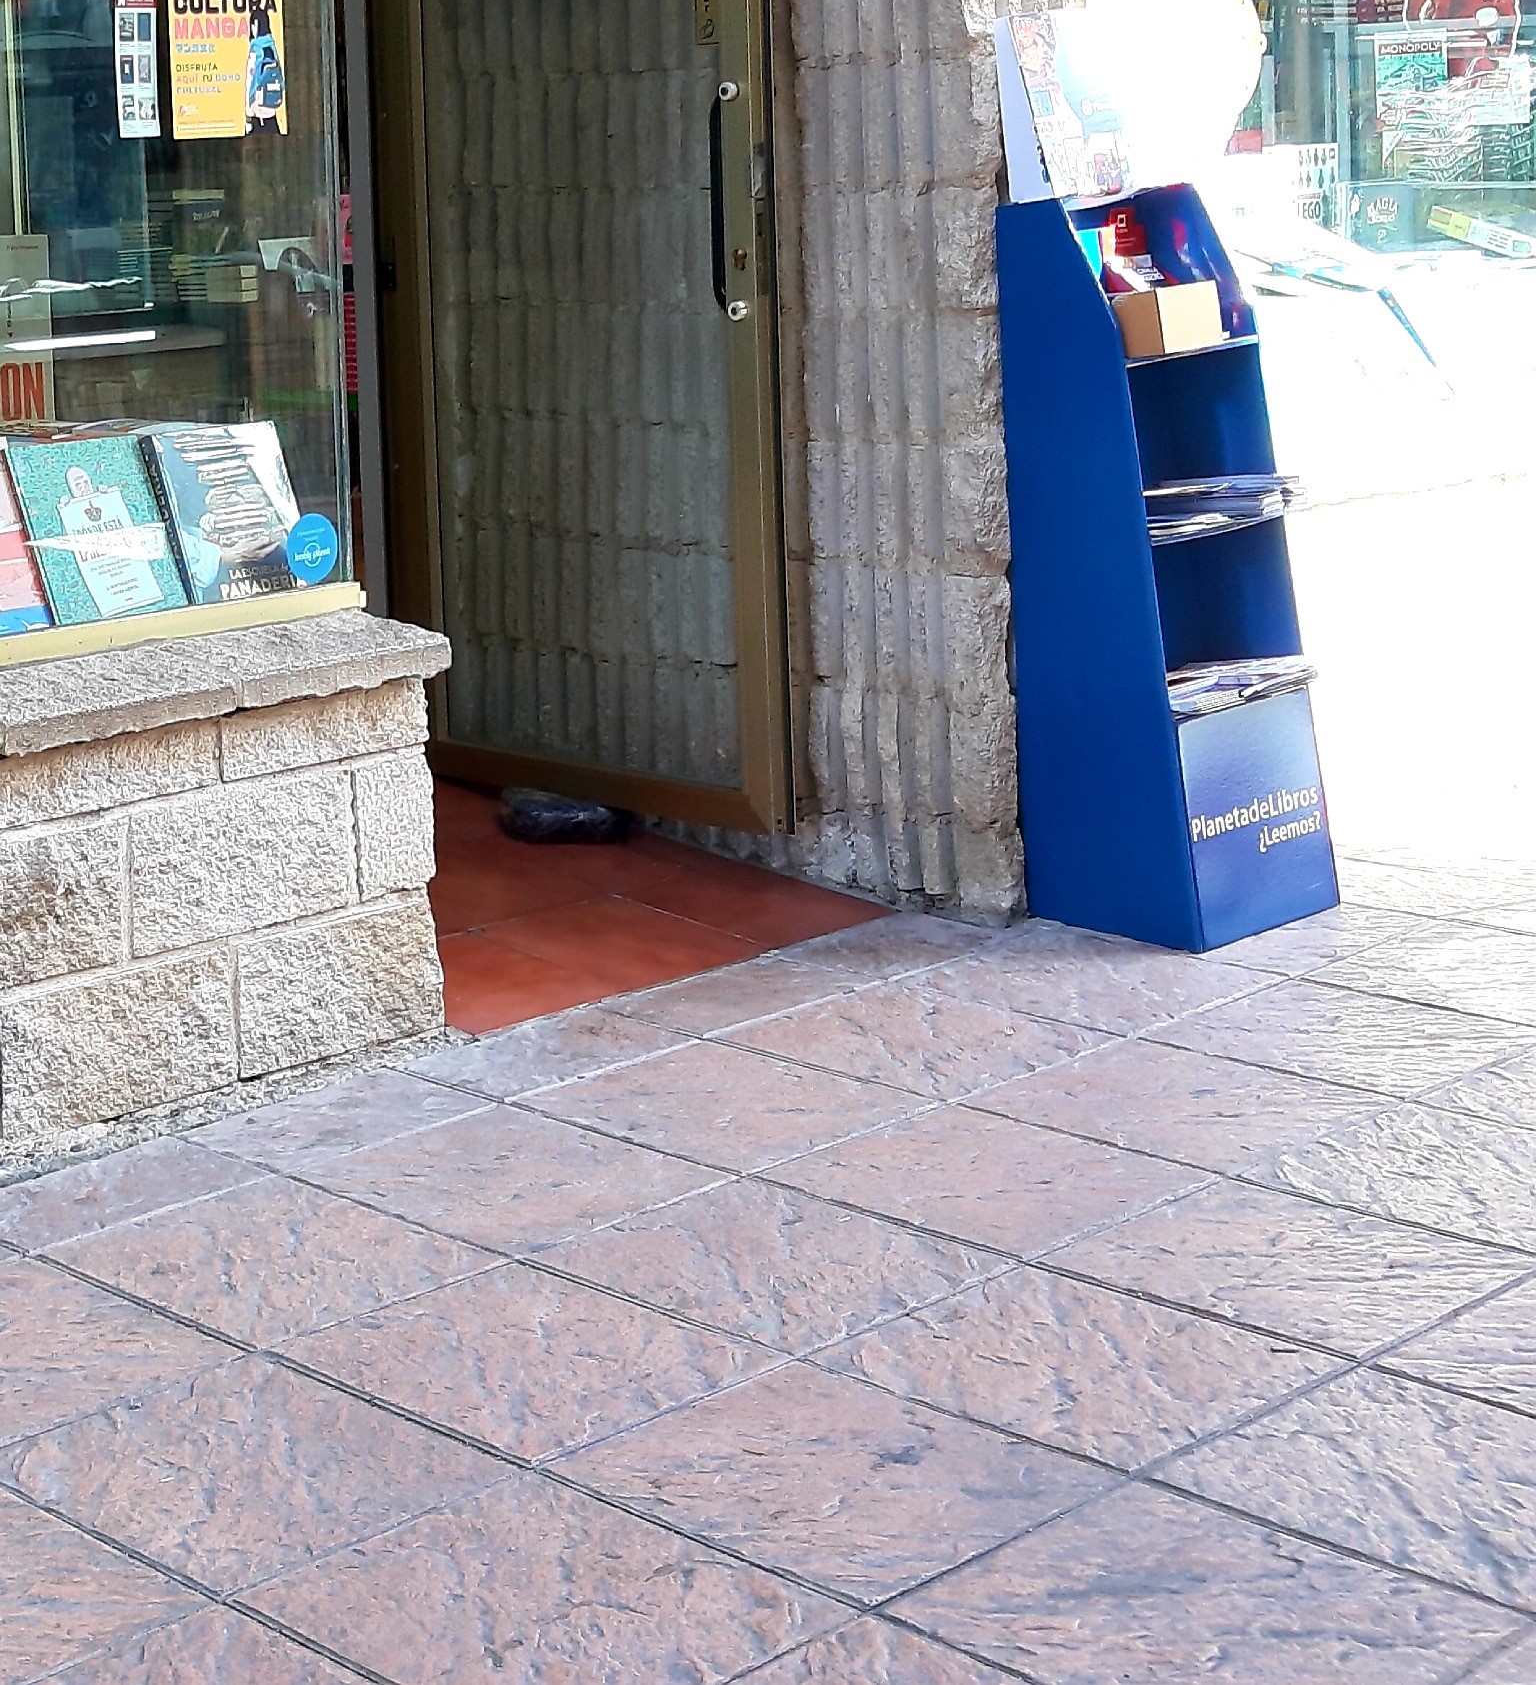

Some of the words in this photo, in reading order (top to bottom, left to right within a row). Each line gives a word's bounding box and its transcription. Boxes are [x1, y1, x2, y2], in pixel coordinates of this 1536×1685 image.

[174, 17, 249, 40] MANGA
[1380, 41, 1441, 54] MONOPOLY
[1191, 785, 1318, 843] PlanetadeLibros
[1257, 811, 1322, 853] ¿Leemos?
